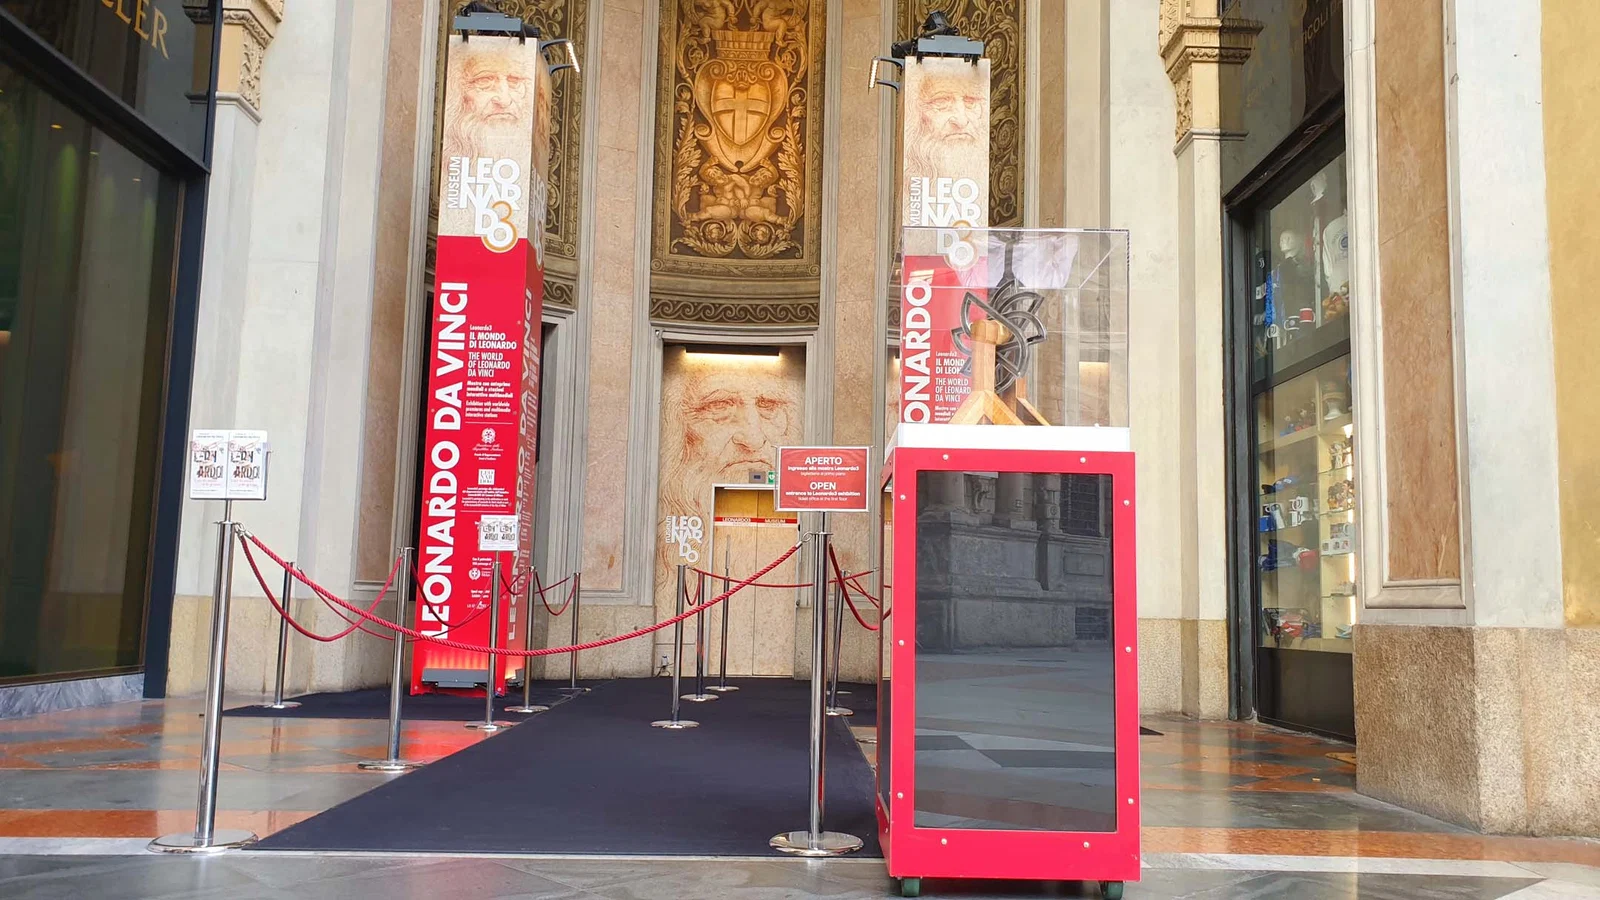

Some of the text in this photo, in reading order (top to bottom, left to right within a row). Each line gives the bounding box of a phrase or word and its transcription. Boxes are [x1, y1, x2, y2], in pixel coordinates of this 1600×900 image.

[447, 156, 461, 209] MUSEUM
[910, 176, 921, 227] MUSEUM
[469, 332, 506, 341] IL MONDO
[522, 288, 533, 381] VINCI
[479, 341, 517, 350] LEONARDO
[468, 352, 503, 360] THE WORLD
[478, 361, 510, 370] LEONARDO
[936, 358, 965, 366] IL MOND
[467, 369, 476, 377] DA
[936, 366, 943, 374] DI
[945, 387, 972, 395] LEONARD
[520, 390, 529, 436] DA
[421, 282, 469, 640] LEONARDO DA VINCI
[804, 456, 842, 465] APERTO
[809, 482, 836, 490] OPEN
